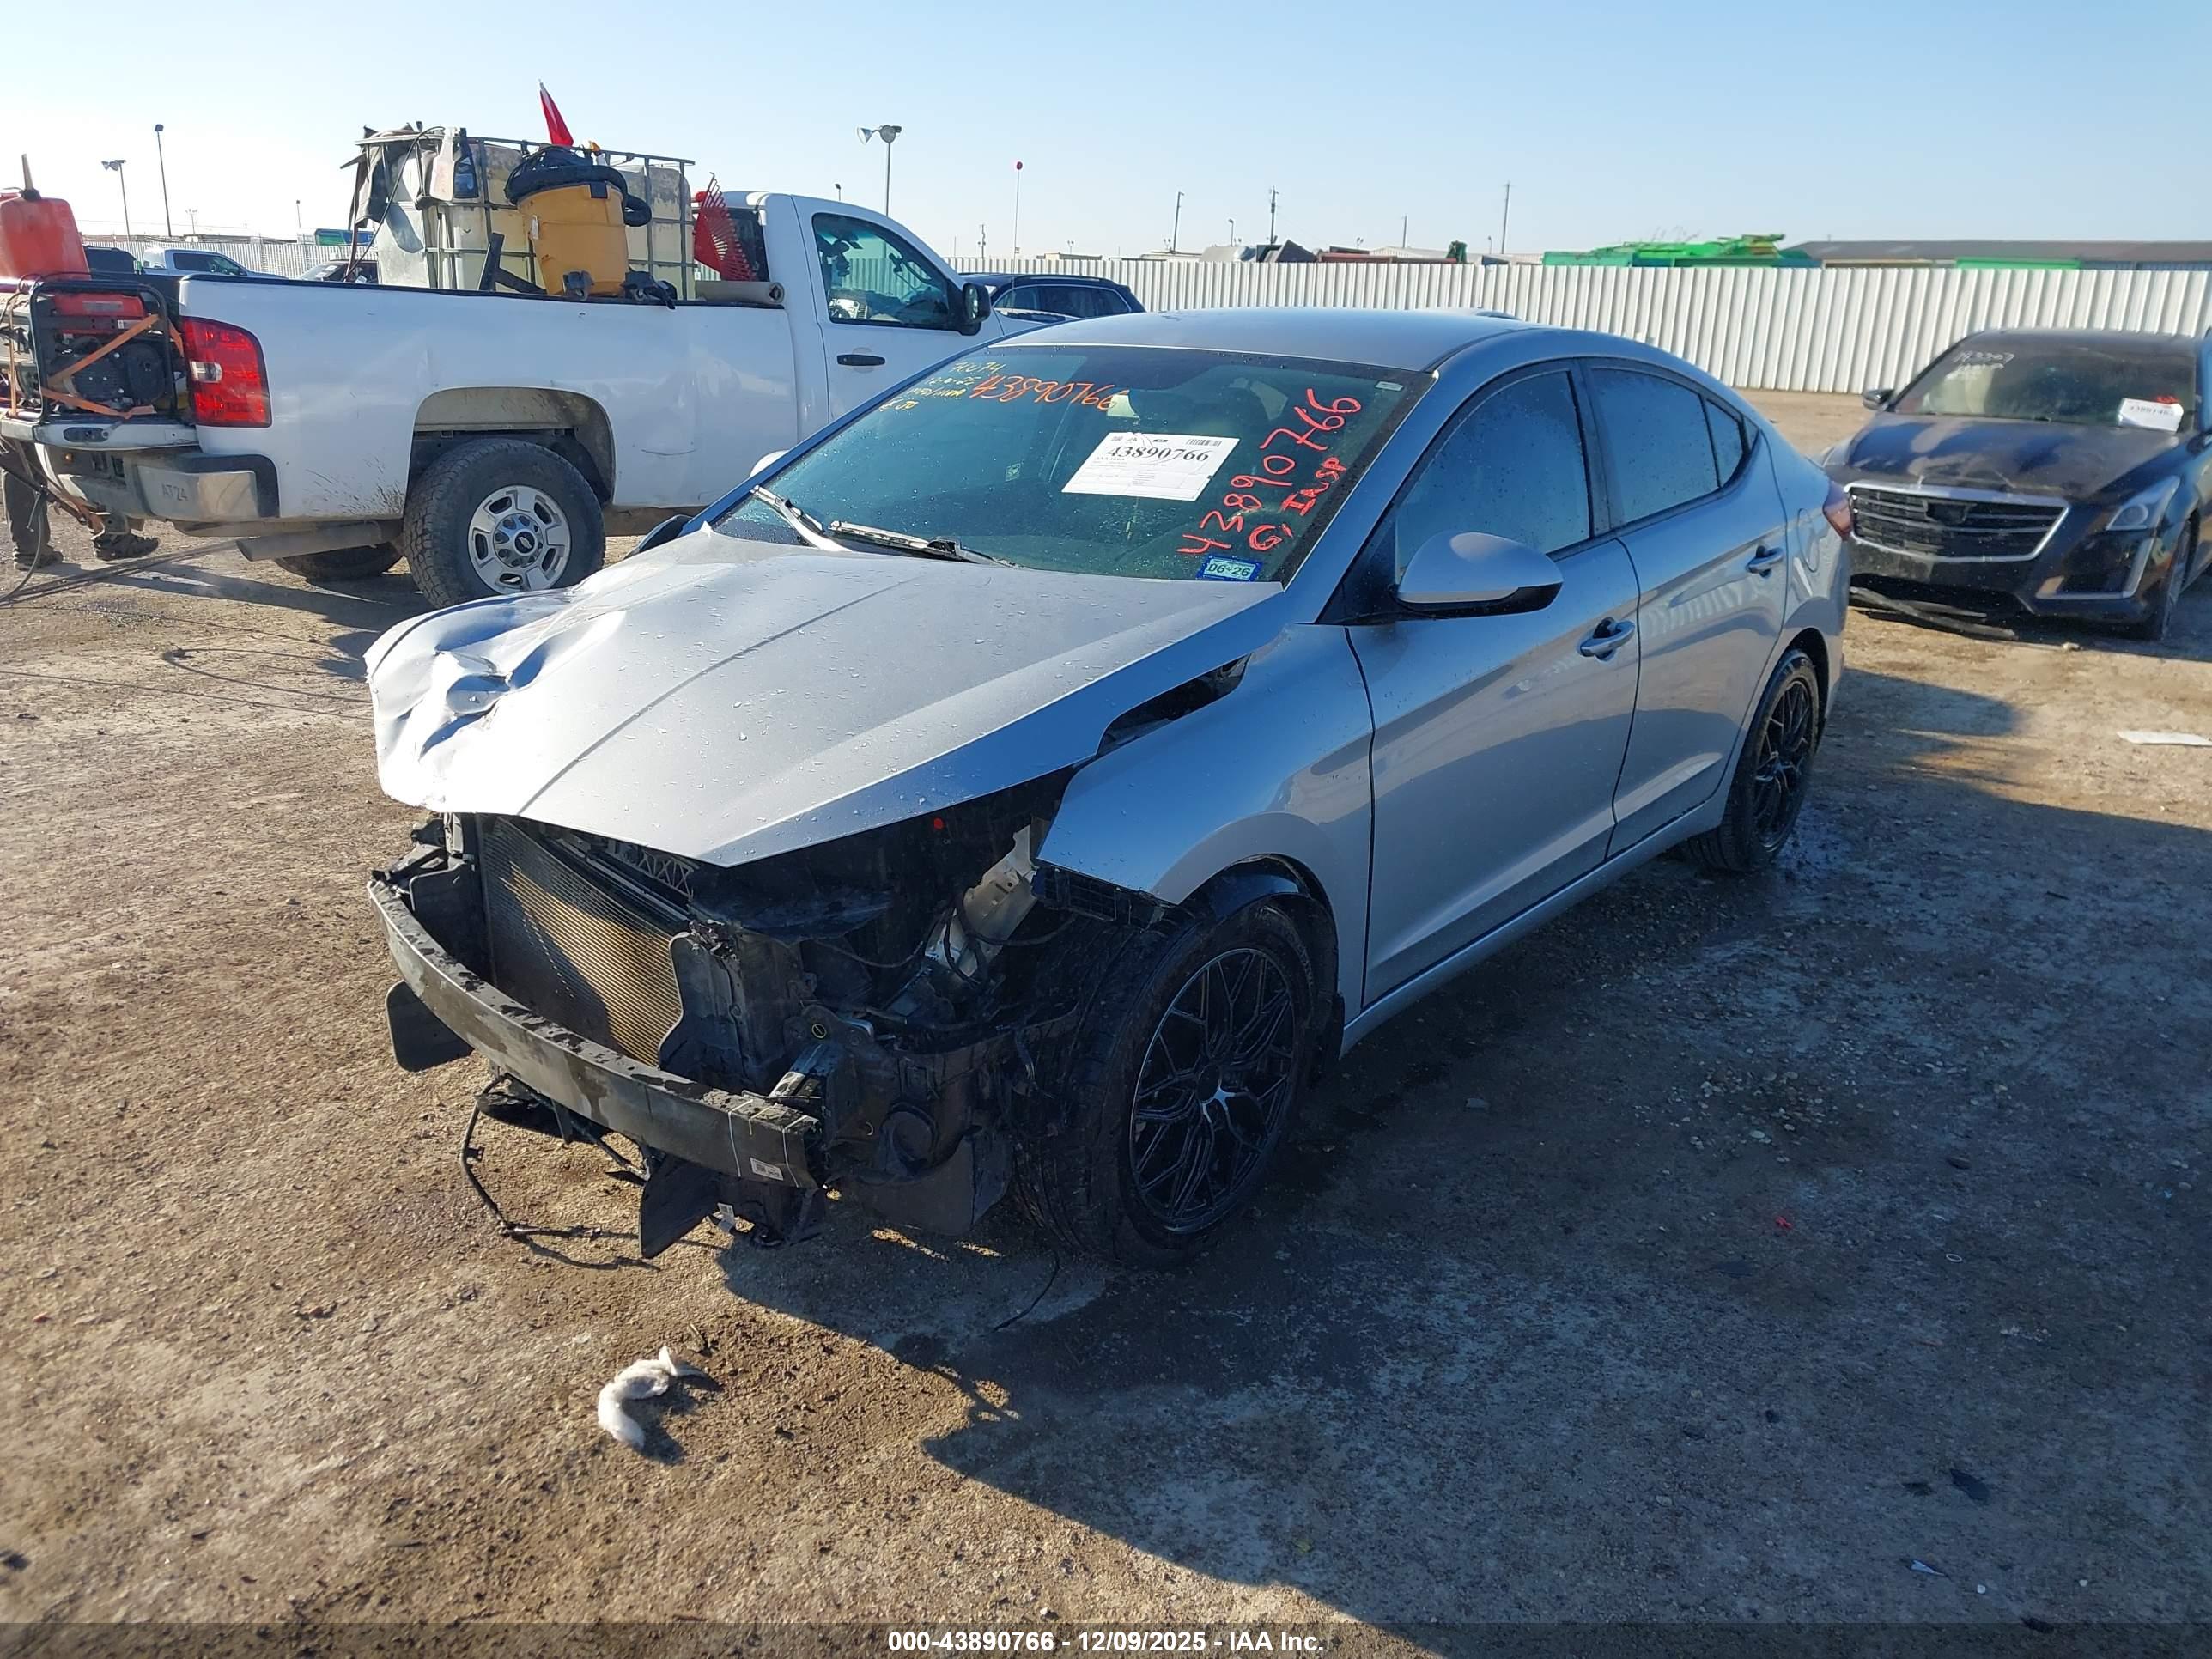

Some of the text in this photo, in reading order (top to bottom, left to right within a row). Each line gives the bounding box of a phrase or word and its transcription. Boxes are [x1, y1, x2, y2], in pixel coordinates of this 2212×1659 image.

[969, 374, 1130, 410] 43890766
[1107, 446, 1213, 462] 43890766
[1176, 388, 1362, 554] 43890766
